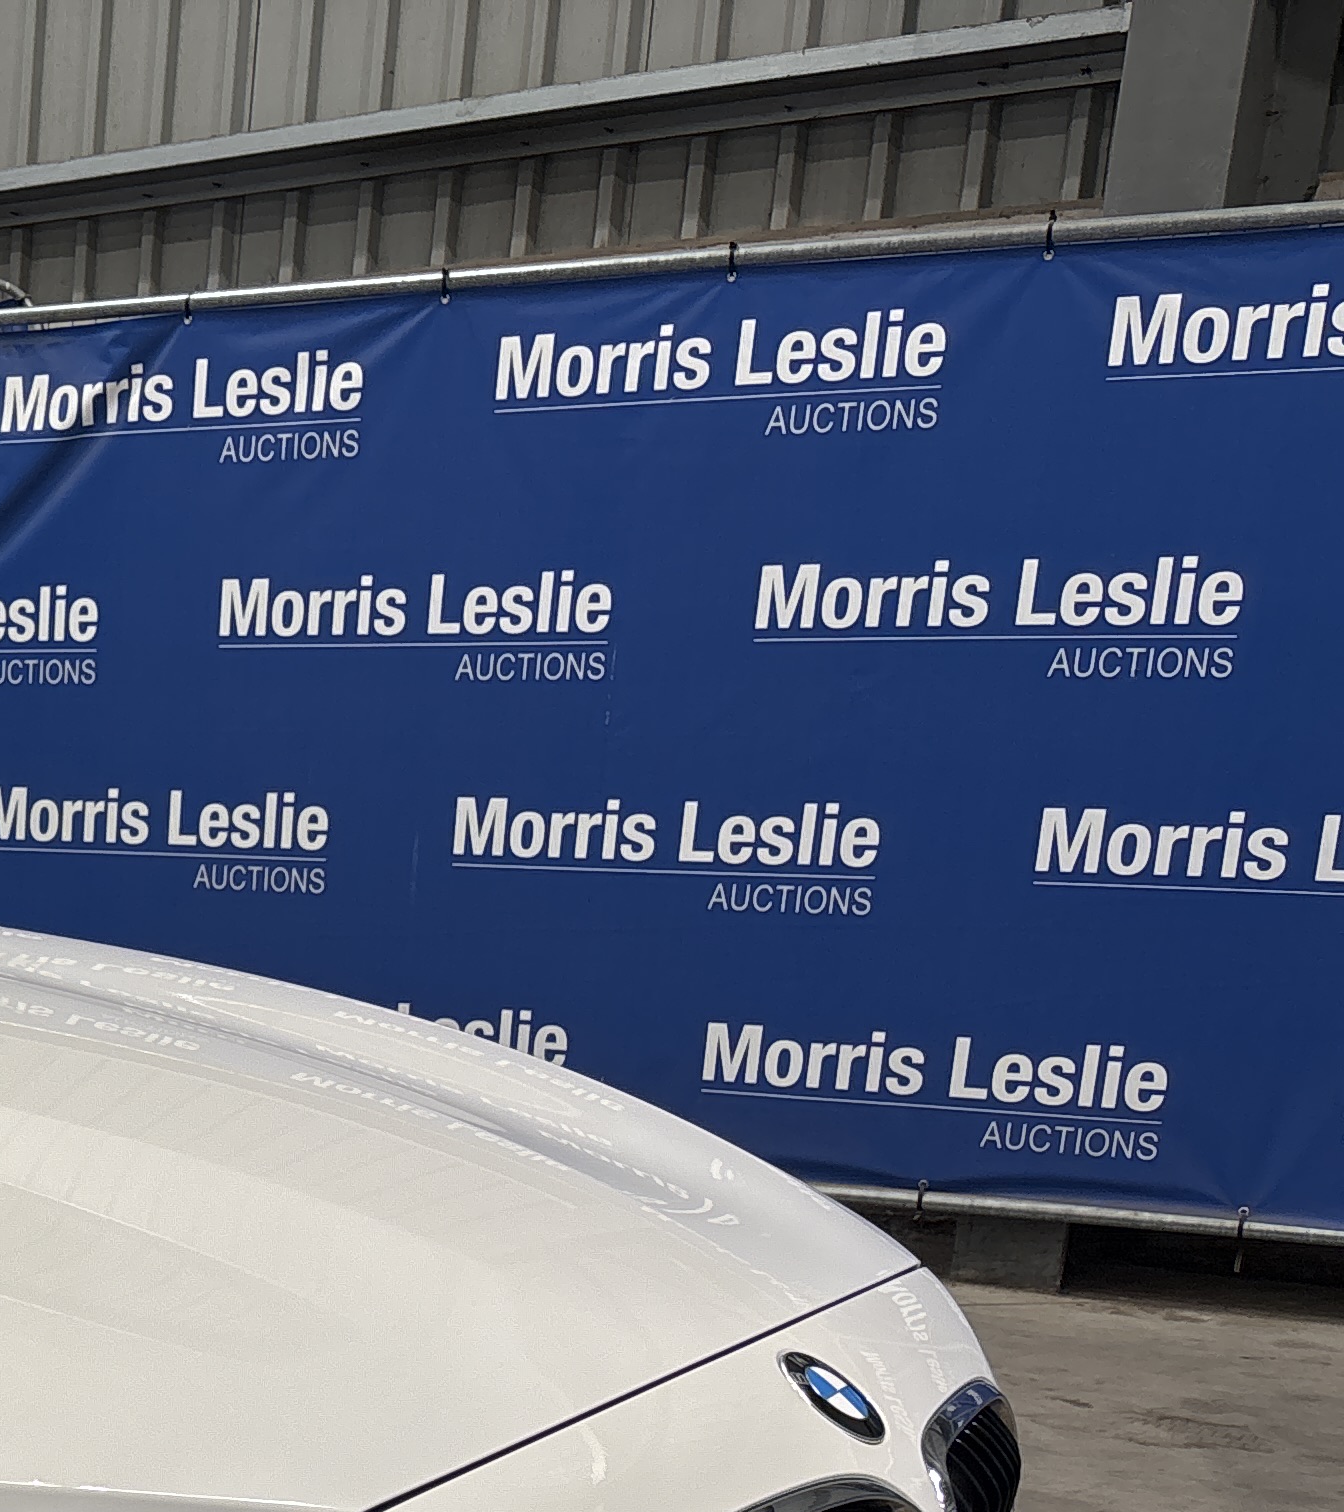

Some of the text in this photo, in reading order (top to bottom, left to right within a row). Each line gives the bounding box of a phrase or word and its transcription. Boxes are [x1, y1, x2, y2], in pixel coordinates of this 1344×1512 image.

[496, 309, 946, 400] Morris Leslie
[0, 350, 363, 432] Morris Leslie
[765, 398, 937, 435] AUCTIONS
[220, 430, 358, 463] AUCTIONS
[219, 570, 611, 636] Morris Leslie
[755, 556, 1243, 629] Morris Leslie
[455, 652, 605, 680] AUCTIONS
[1047, 648, 1233, 677] AUCTIONS
[168, 790, 328, 850] Leslie
[453, 797, 879, 867] Morris Leslie
[1035, 808, 1288, 880] Morris
[194, 864, 324, 893] AUCTIONS
[708, 883, 871, 915] AUCTIONS
[398, 1003, 568, 1066] slie
[702, 1022, 924, 1095] Morris
[949, 1037, 1167, 1111] Leslie
[980, 1122, 1158, 1160] AUCTIONS
